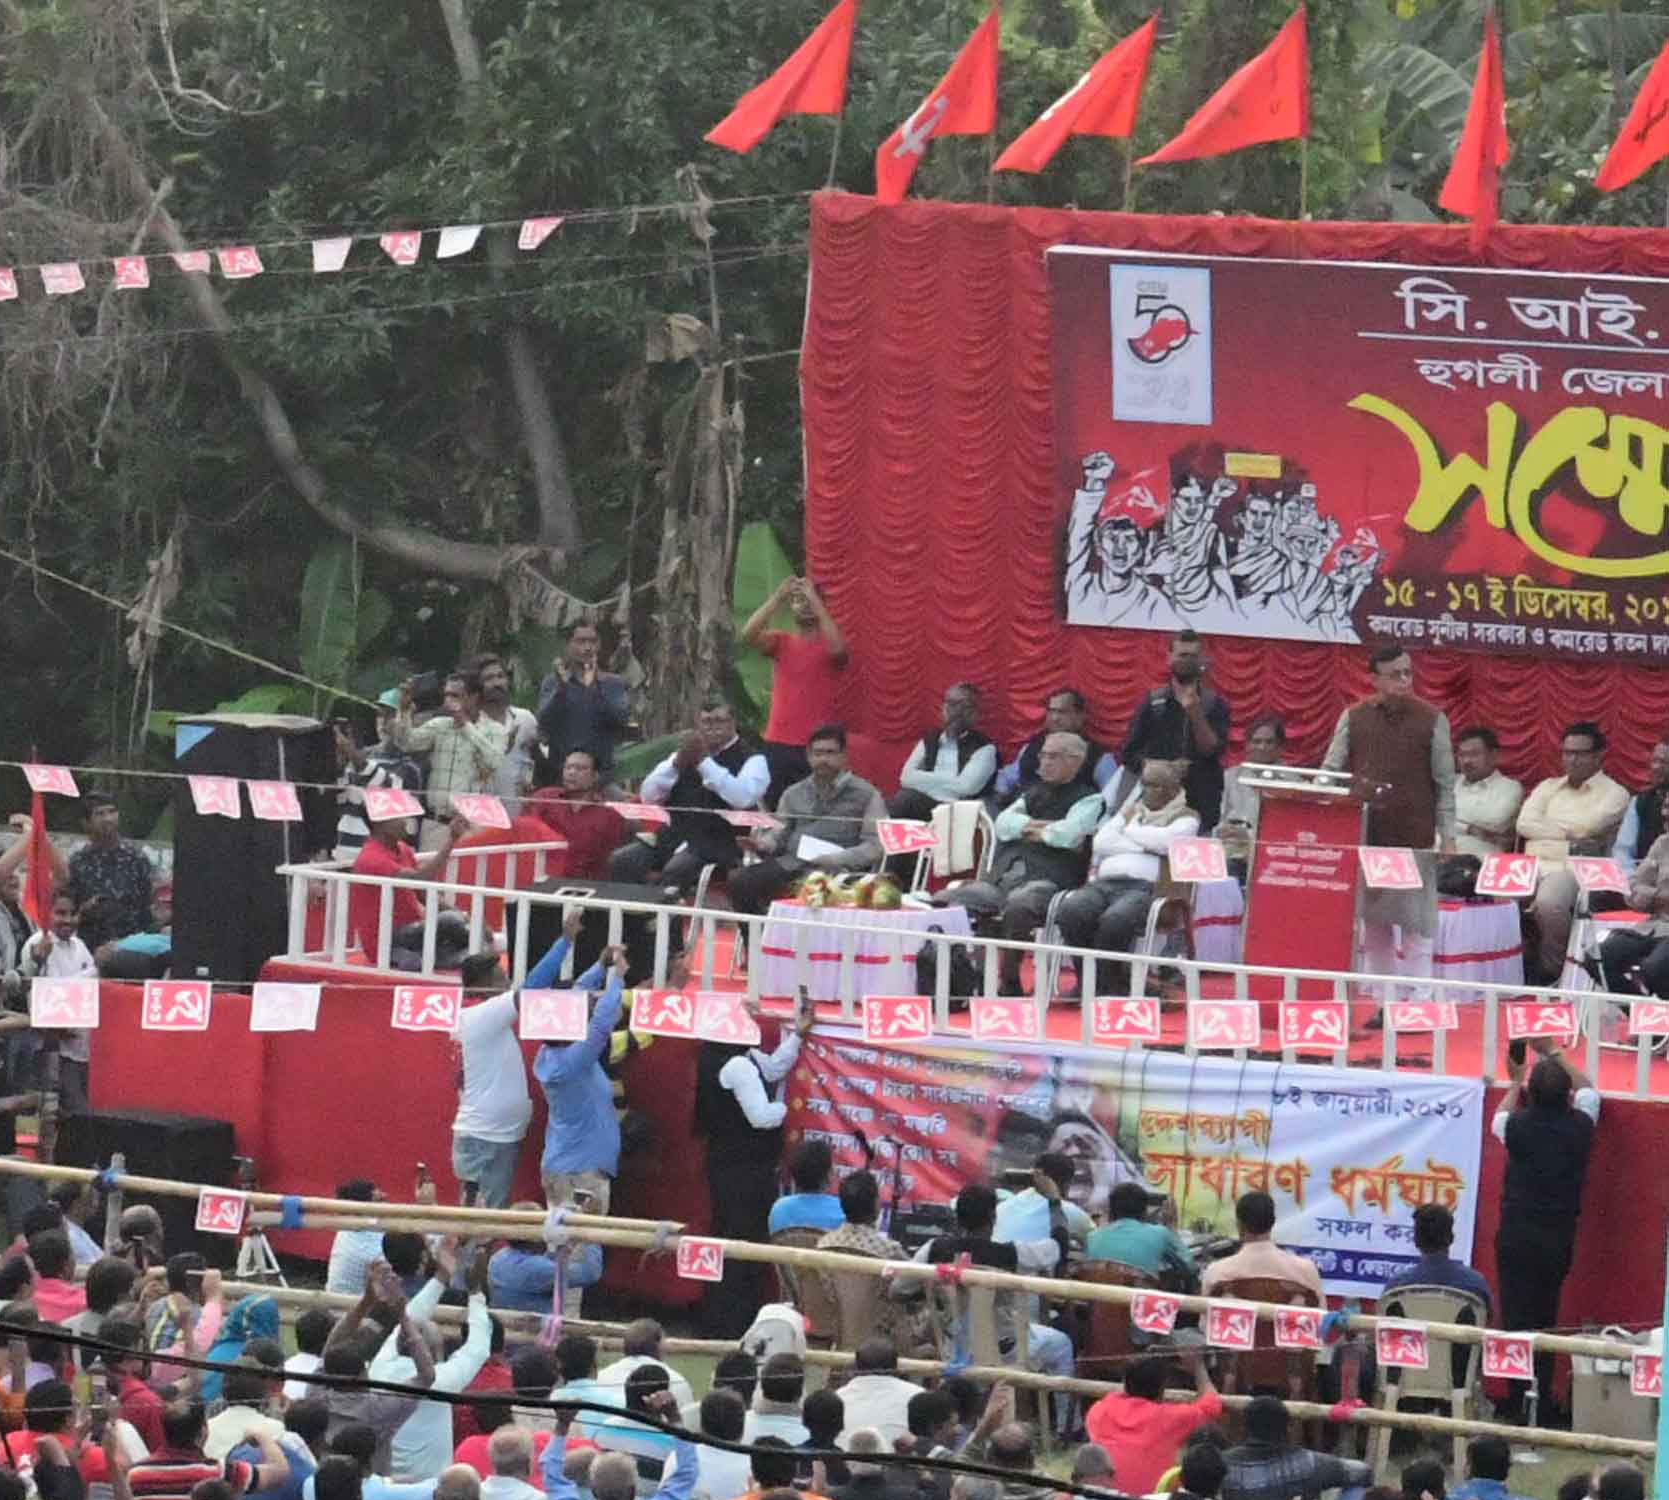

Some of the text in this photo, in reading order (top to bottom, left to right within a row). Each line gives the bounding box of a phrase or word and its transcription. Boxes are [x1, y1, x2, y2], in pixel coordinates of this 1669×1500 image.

[1393, 276, 1659, 346] সি. আই.
[1414, 353, 1669, 399] হুগলী জেল
[1346, 393, 1669, 577] সম্মে
[1383, 577, 1415, 607] ১৫
[1447, 581, 1480, 612] ১৭
[1513, 574, 1615, 624] ডিসেম্বর,
[1624, 592, 1669, 626] ২০
[1144, 1152, 1466, 1217] সাধারণ ধর্মঘট
[1316, 1216, 1372, 1241] সফল
